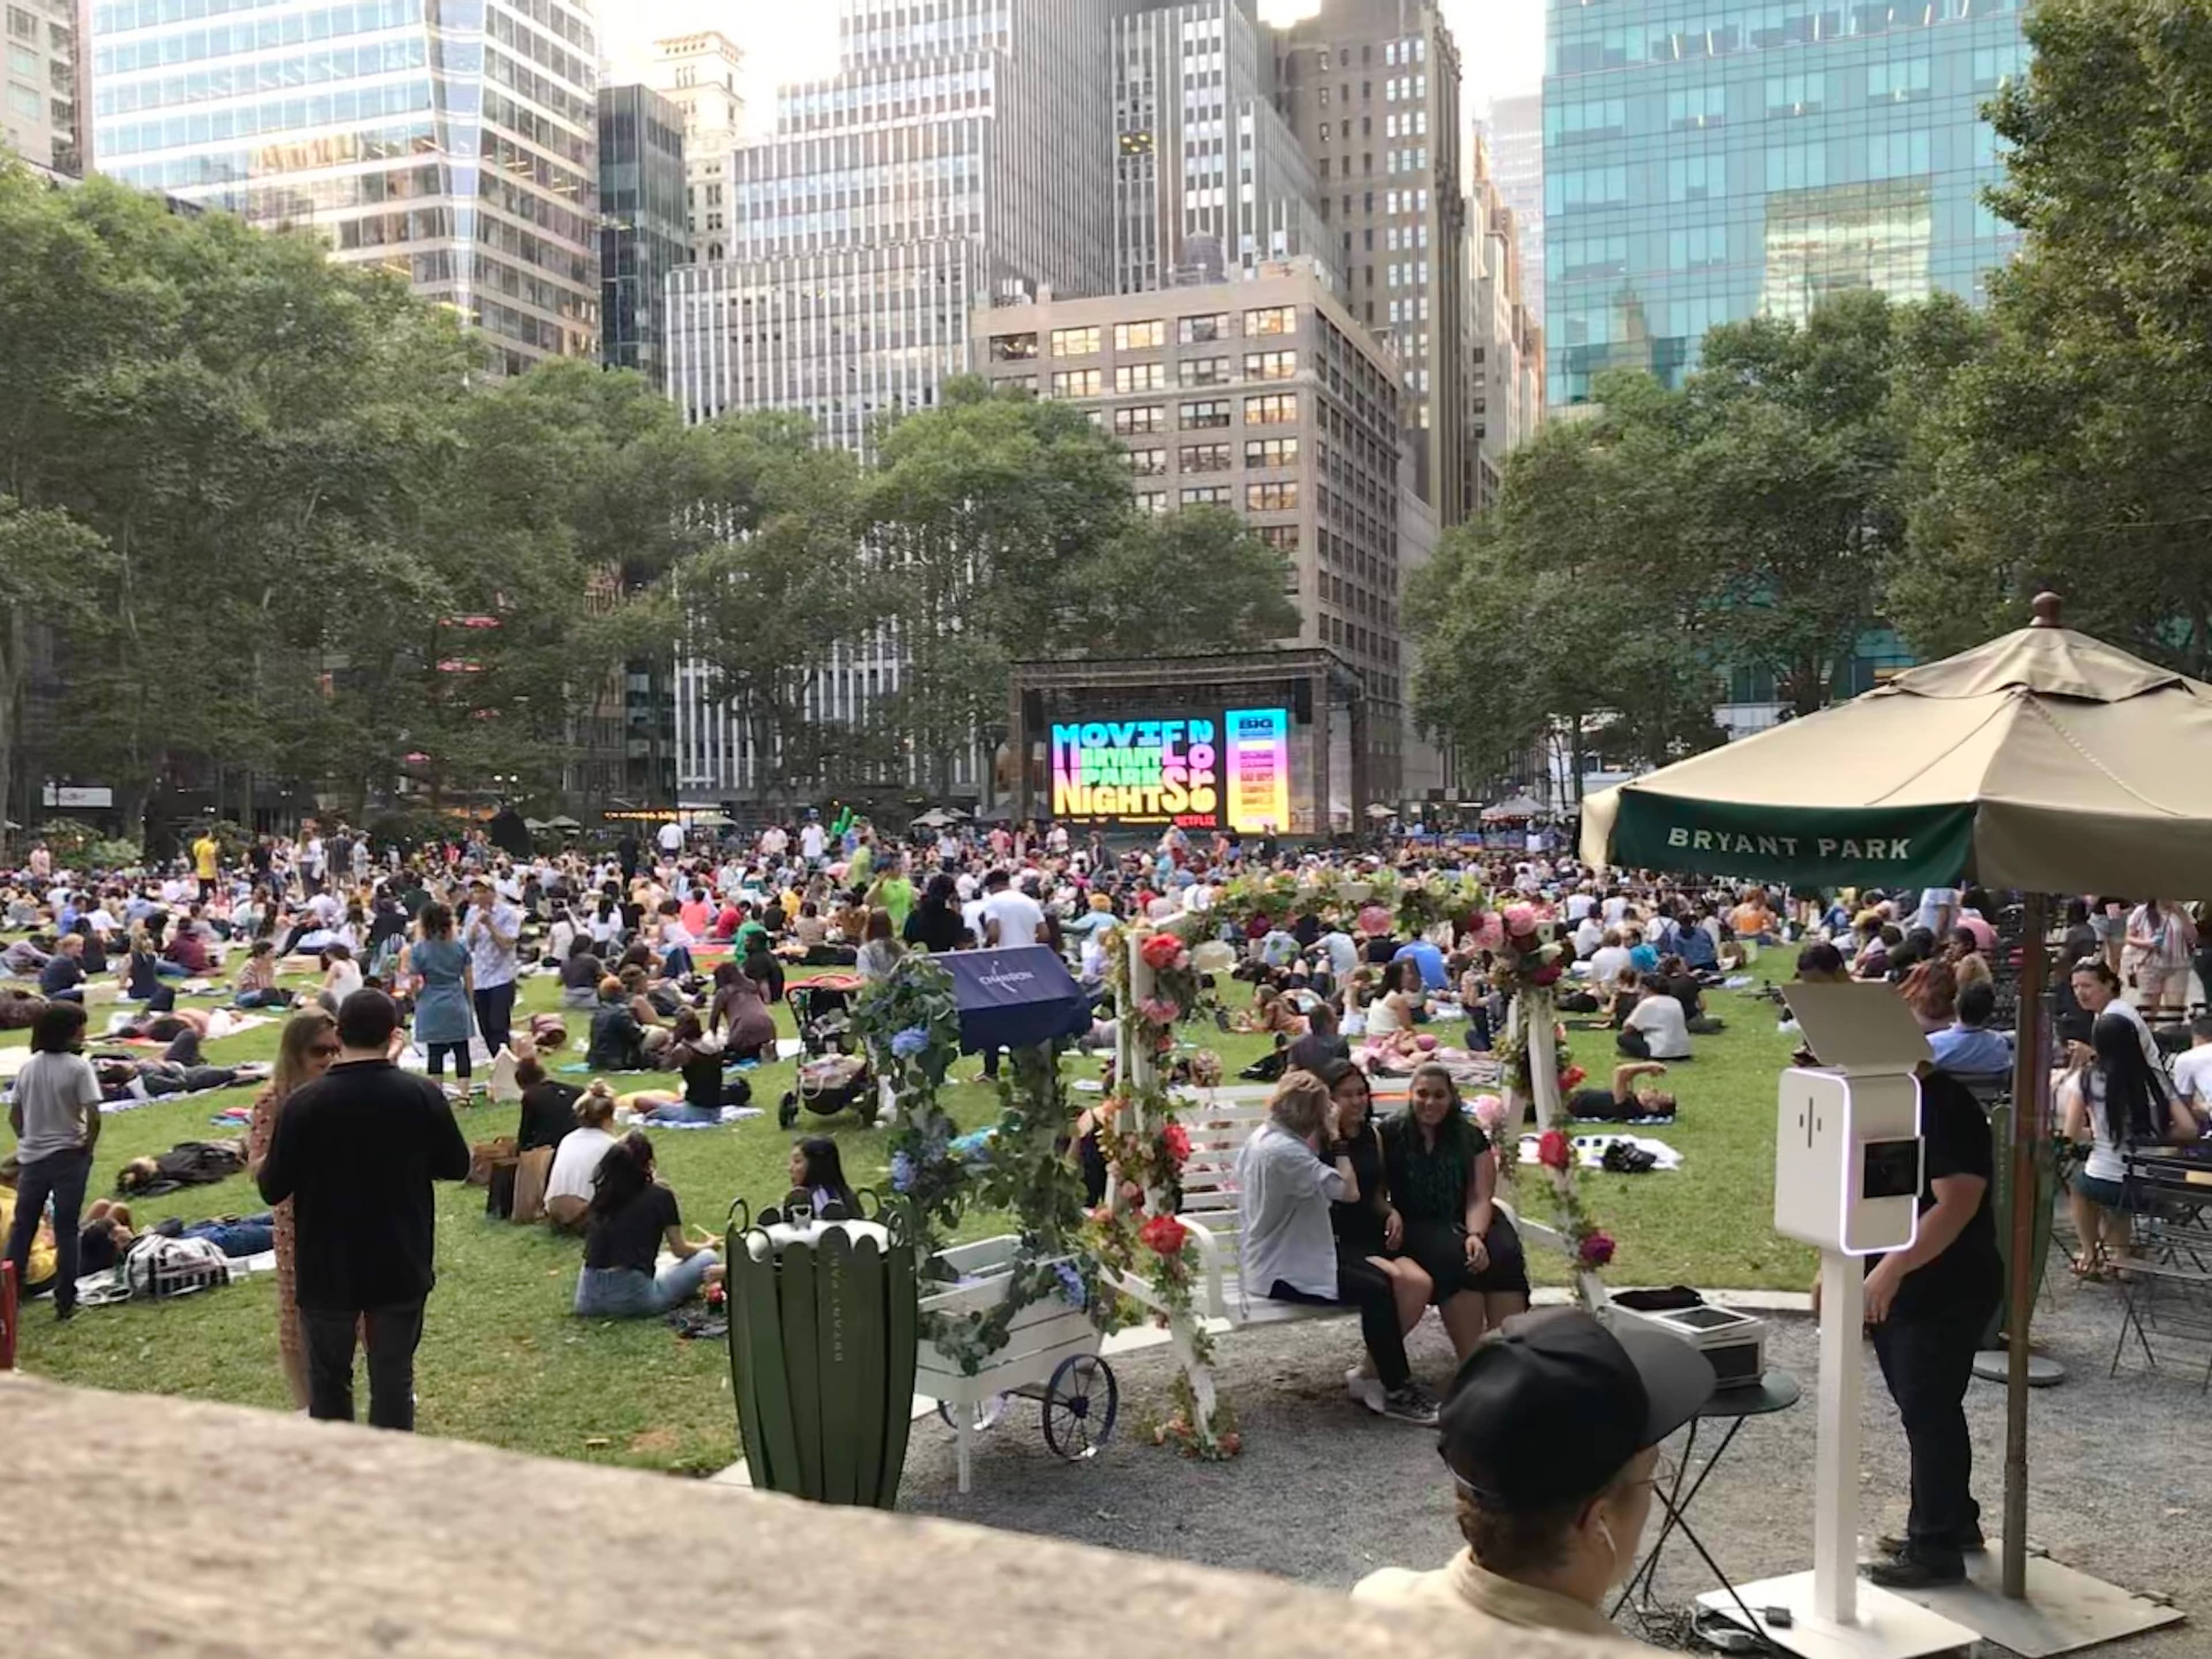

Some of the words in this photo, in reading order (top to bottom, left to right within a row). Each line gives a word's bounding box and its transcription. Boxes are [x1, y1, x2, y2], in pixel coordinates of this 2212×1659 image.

[1052, 720, 1187, 768] MOVIE
[1052, 766, 1189, 815] NIGHTS
[1081, 767, 1162, 786] PARK
[1173, 815, 1217, 827] NETFLIX
[1668, 827, 1798, 857] BRYANT
[1817, 838, 1911, 860] PARK
